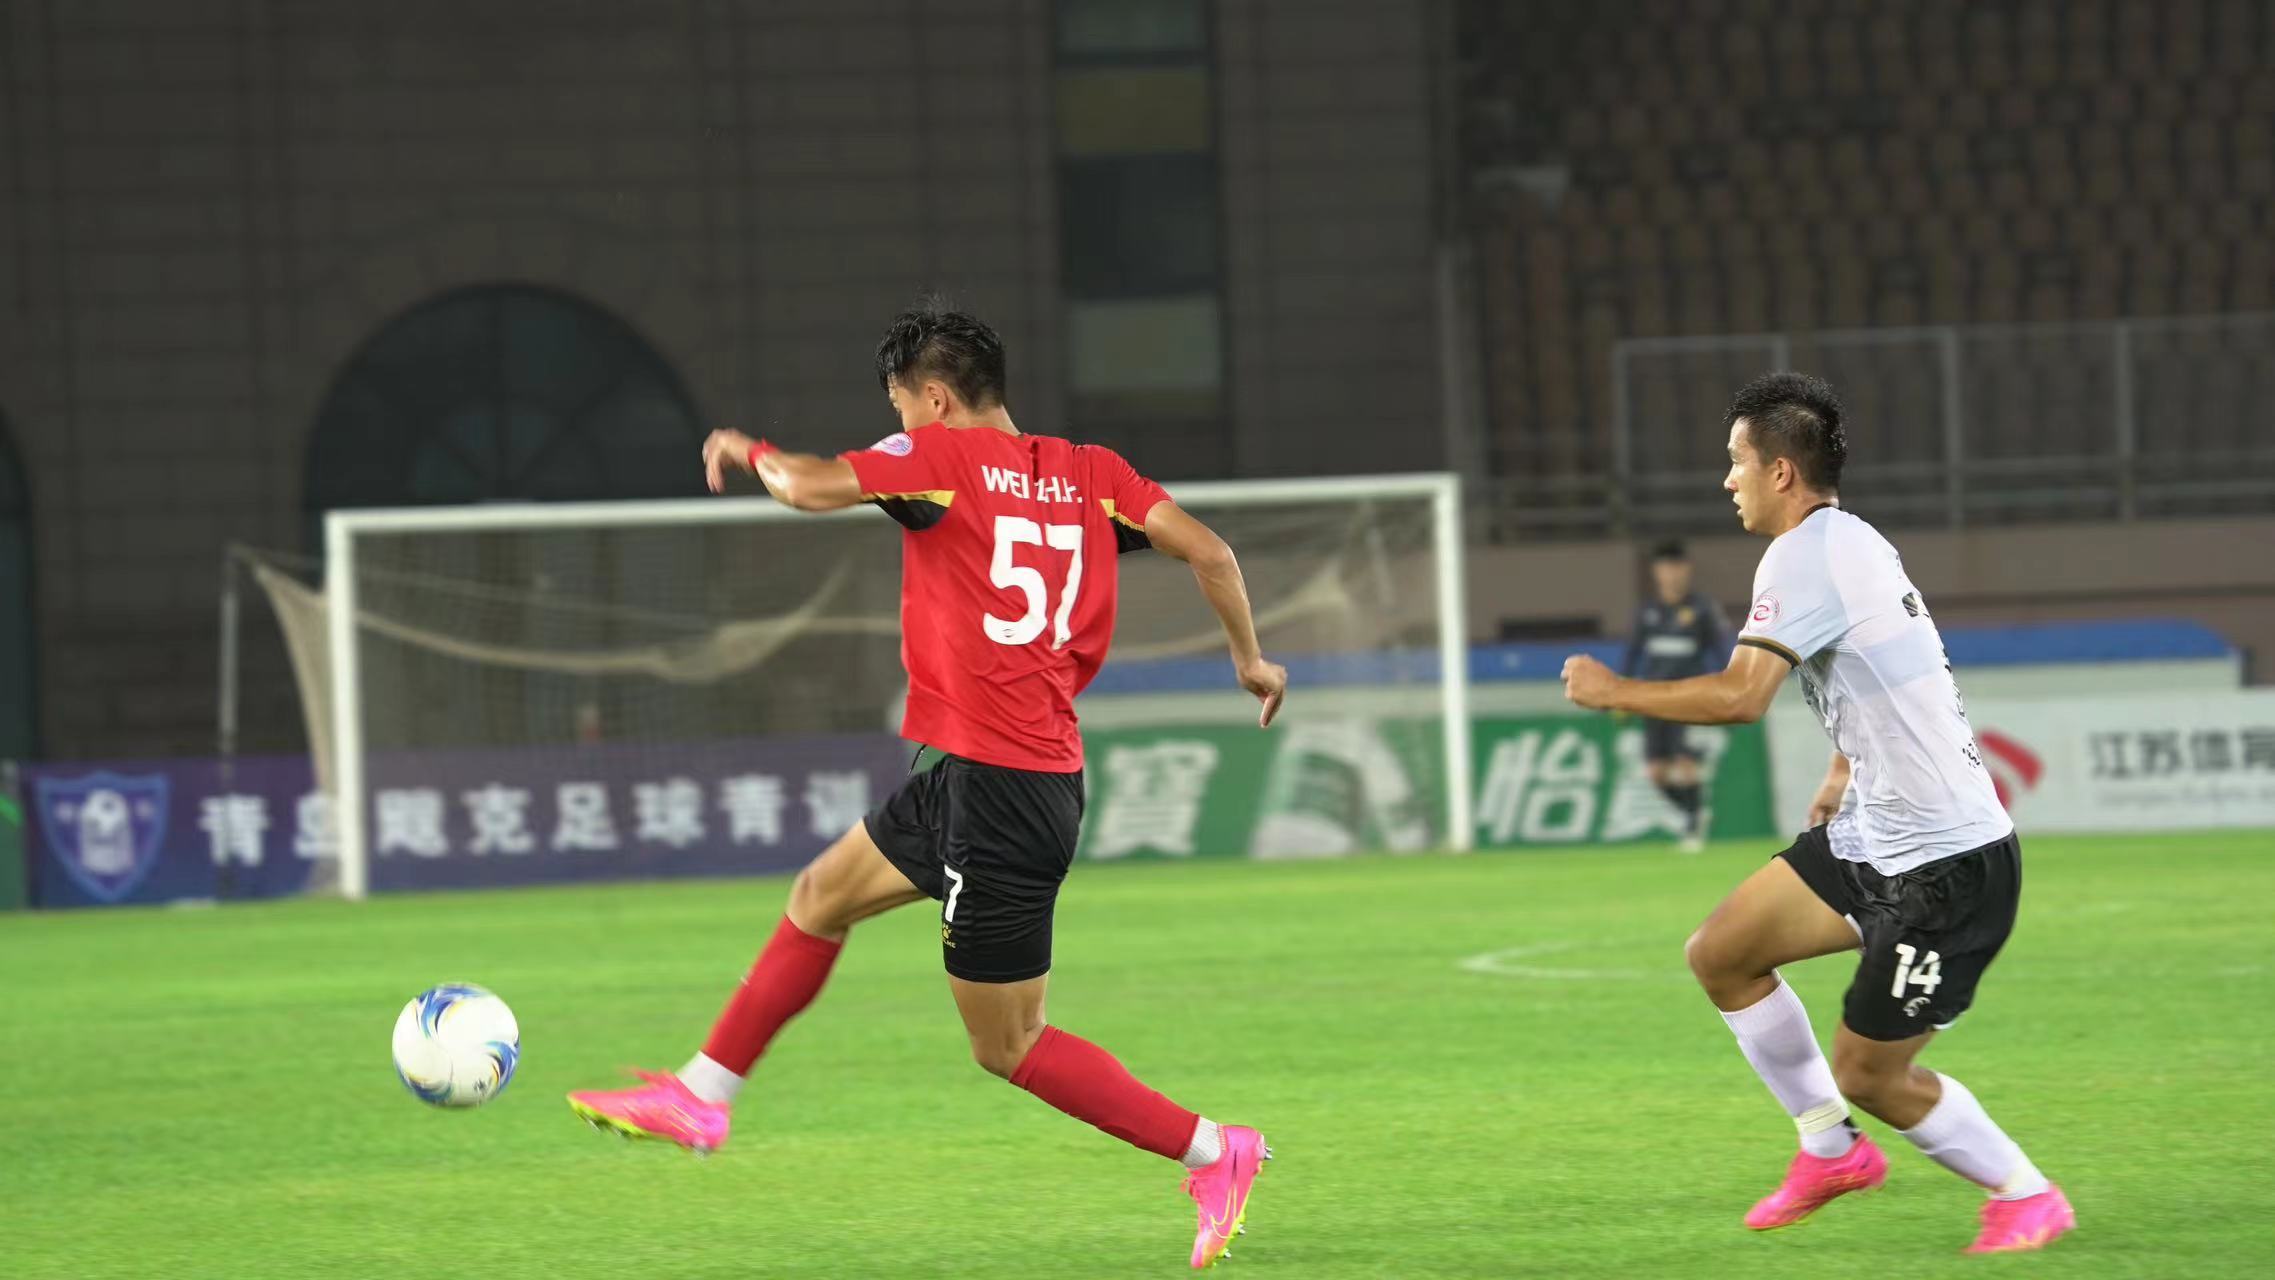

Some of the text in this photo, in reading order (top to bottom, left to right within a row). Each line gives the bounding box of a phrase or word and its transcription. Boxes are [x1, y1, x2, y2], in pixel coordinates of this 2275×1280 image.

[981, 465, 1030, 500] WEI
[982, 515, 1084, 651] 57
[1891, 943, 1943, 999] 14
